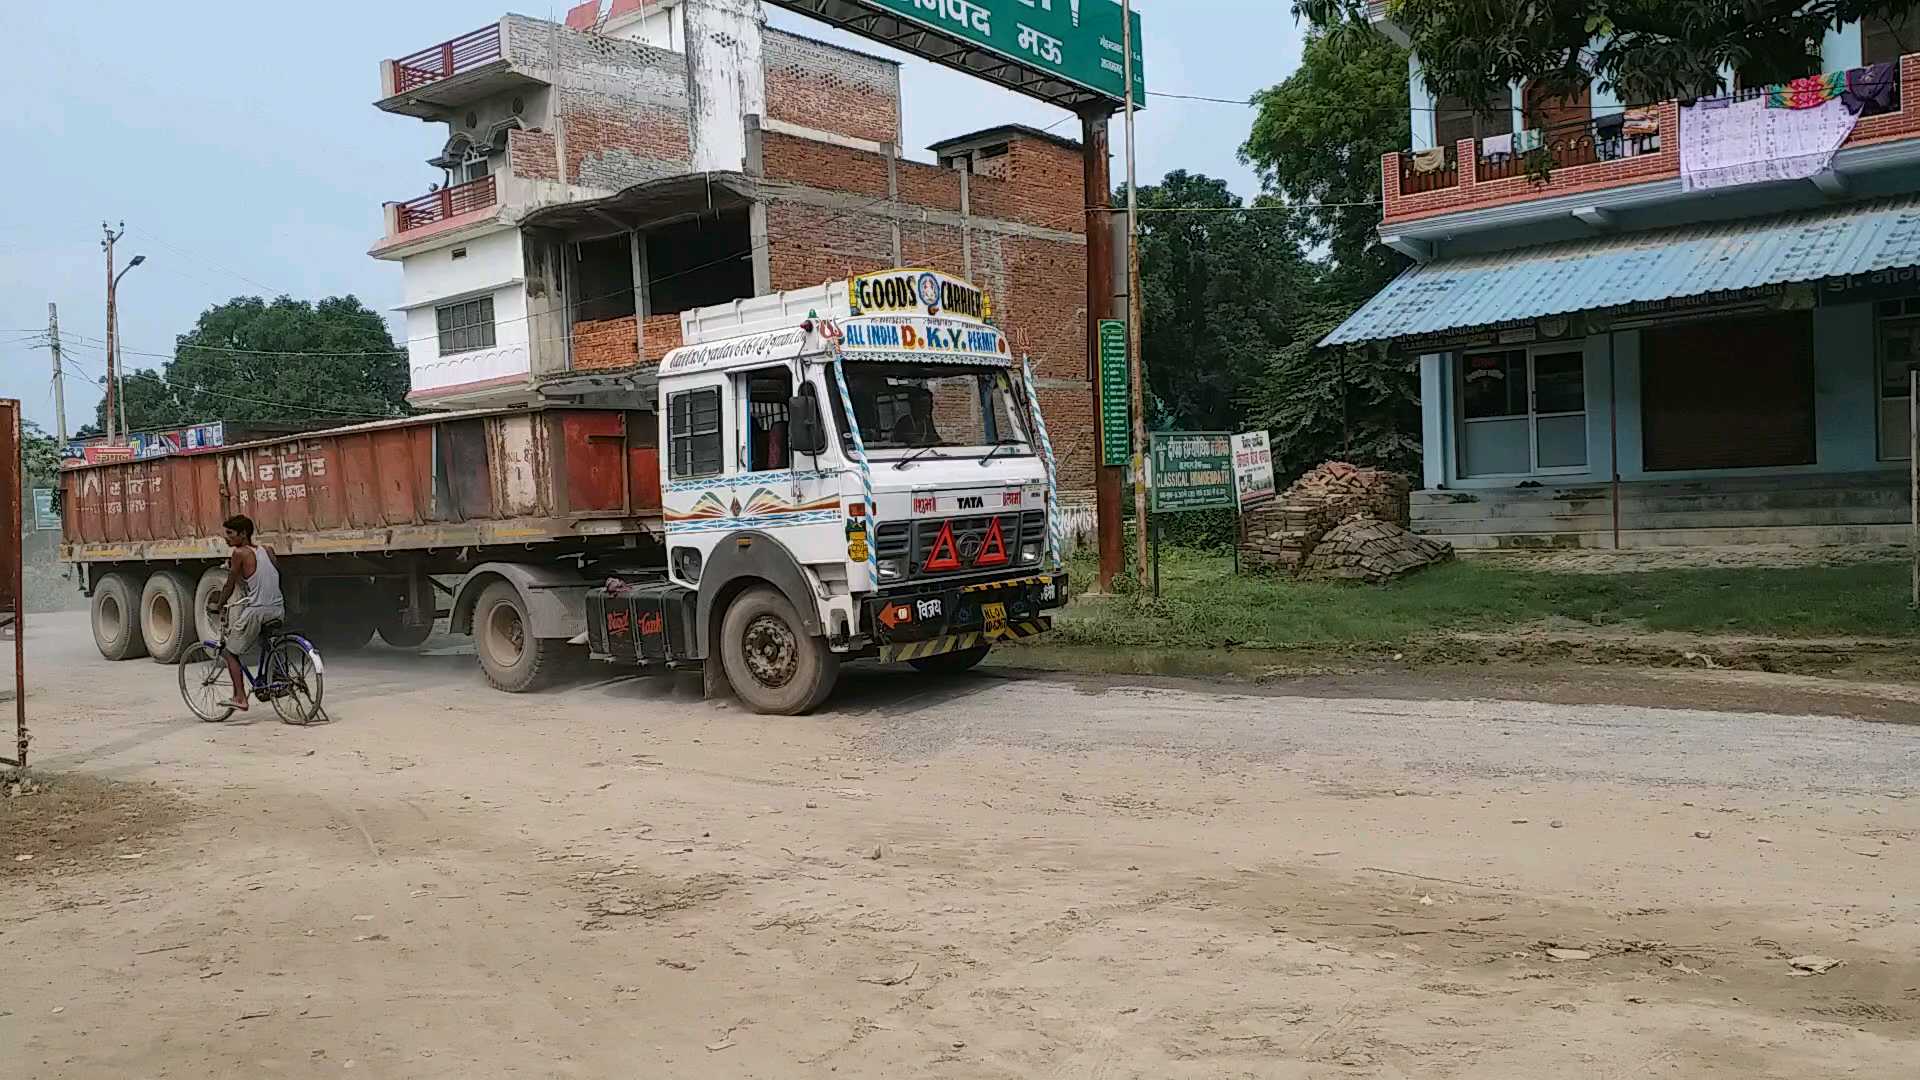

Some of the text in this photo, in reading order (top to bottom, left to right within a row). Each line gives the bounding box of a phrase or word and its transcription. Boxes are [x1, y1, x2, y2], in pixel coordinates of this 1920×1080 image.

[1016, 22, 1063, 64] मऊ
[860, 275, 982, 318] GOODS CARRIER
[846, 325, 865, 346] ALL
[869, 324, 899, 347] INDIA
[967, 331, 997, 353] PERMIT
[1156, 471, 1189, 488] CLASSICAL
[957, 496, 984, 509] TATA
[916, 600, 942, 621] विजय
